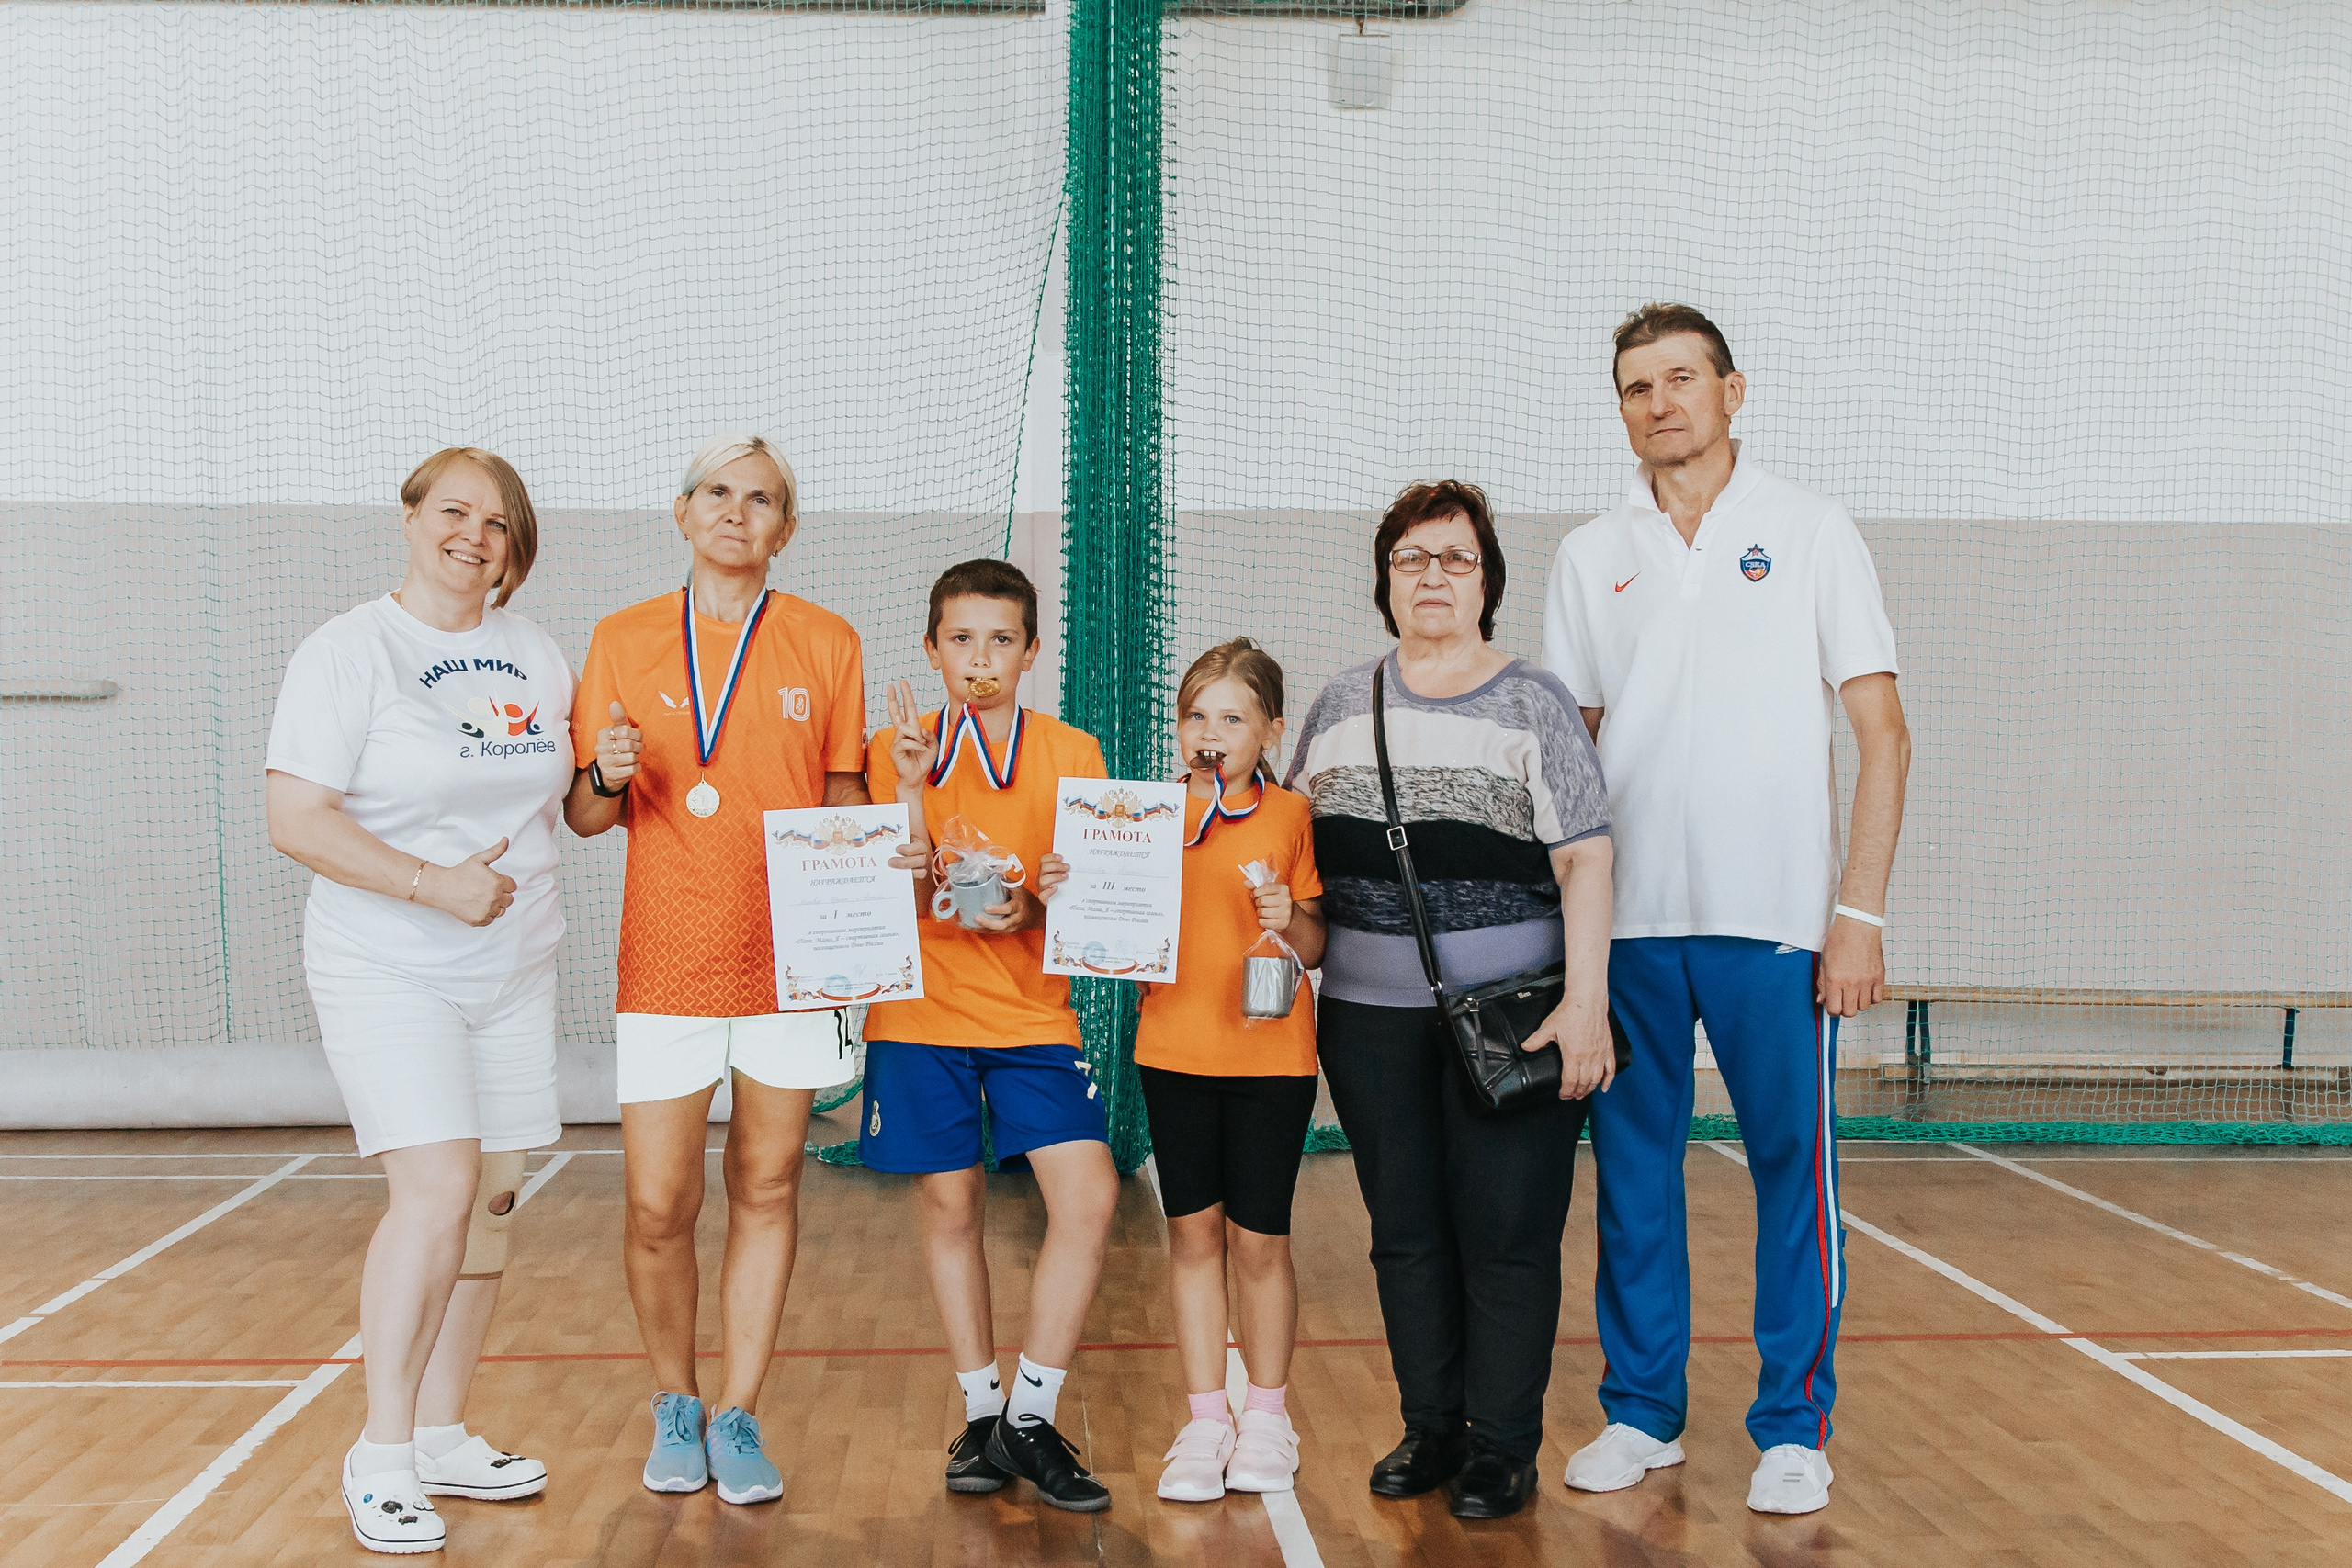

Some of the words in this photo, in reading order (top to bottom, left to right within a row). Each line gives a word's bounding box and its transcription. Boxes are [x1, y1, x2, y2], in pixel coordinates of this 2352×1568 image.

[419, 659, 469, 689] НАШ
[472, 659, 528, 681] МИР
[777, 686, 811, 722] 10
[460, 746, 474, 758] г.
[481, 739, 556, 760] Королёв
[1083, 828, 1152, 843] ГРАМОТА
[1089, 849, 1150, 859] НАГРАЖДАЕТСЯ
[802, 856, 877, 872] ГРАМОТА
[810, 875, 876, 886] НАГРАЖДАЕТСЯ
[1102, 882, 1115, 890] III
